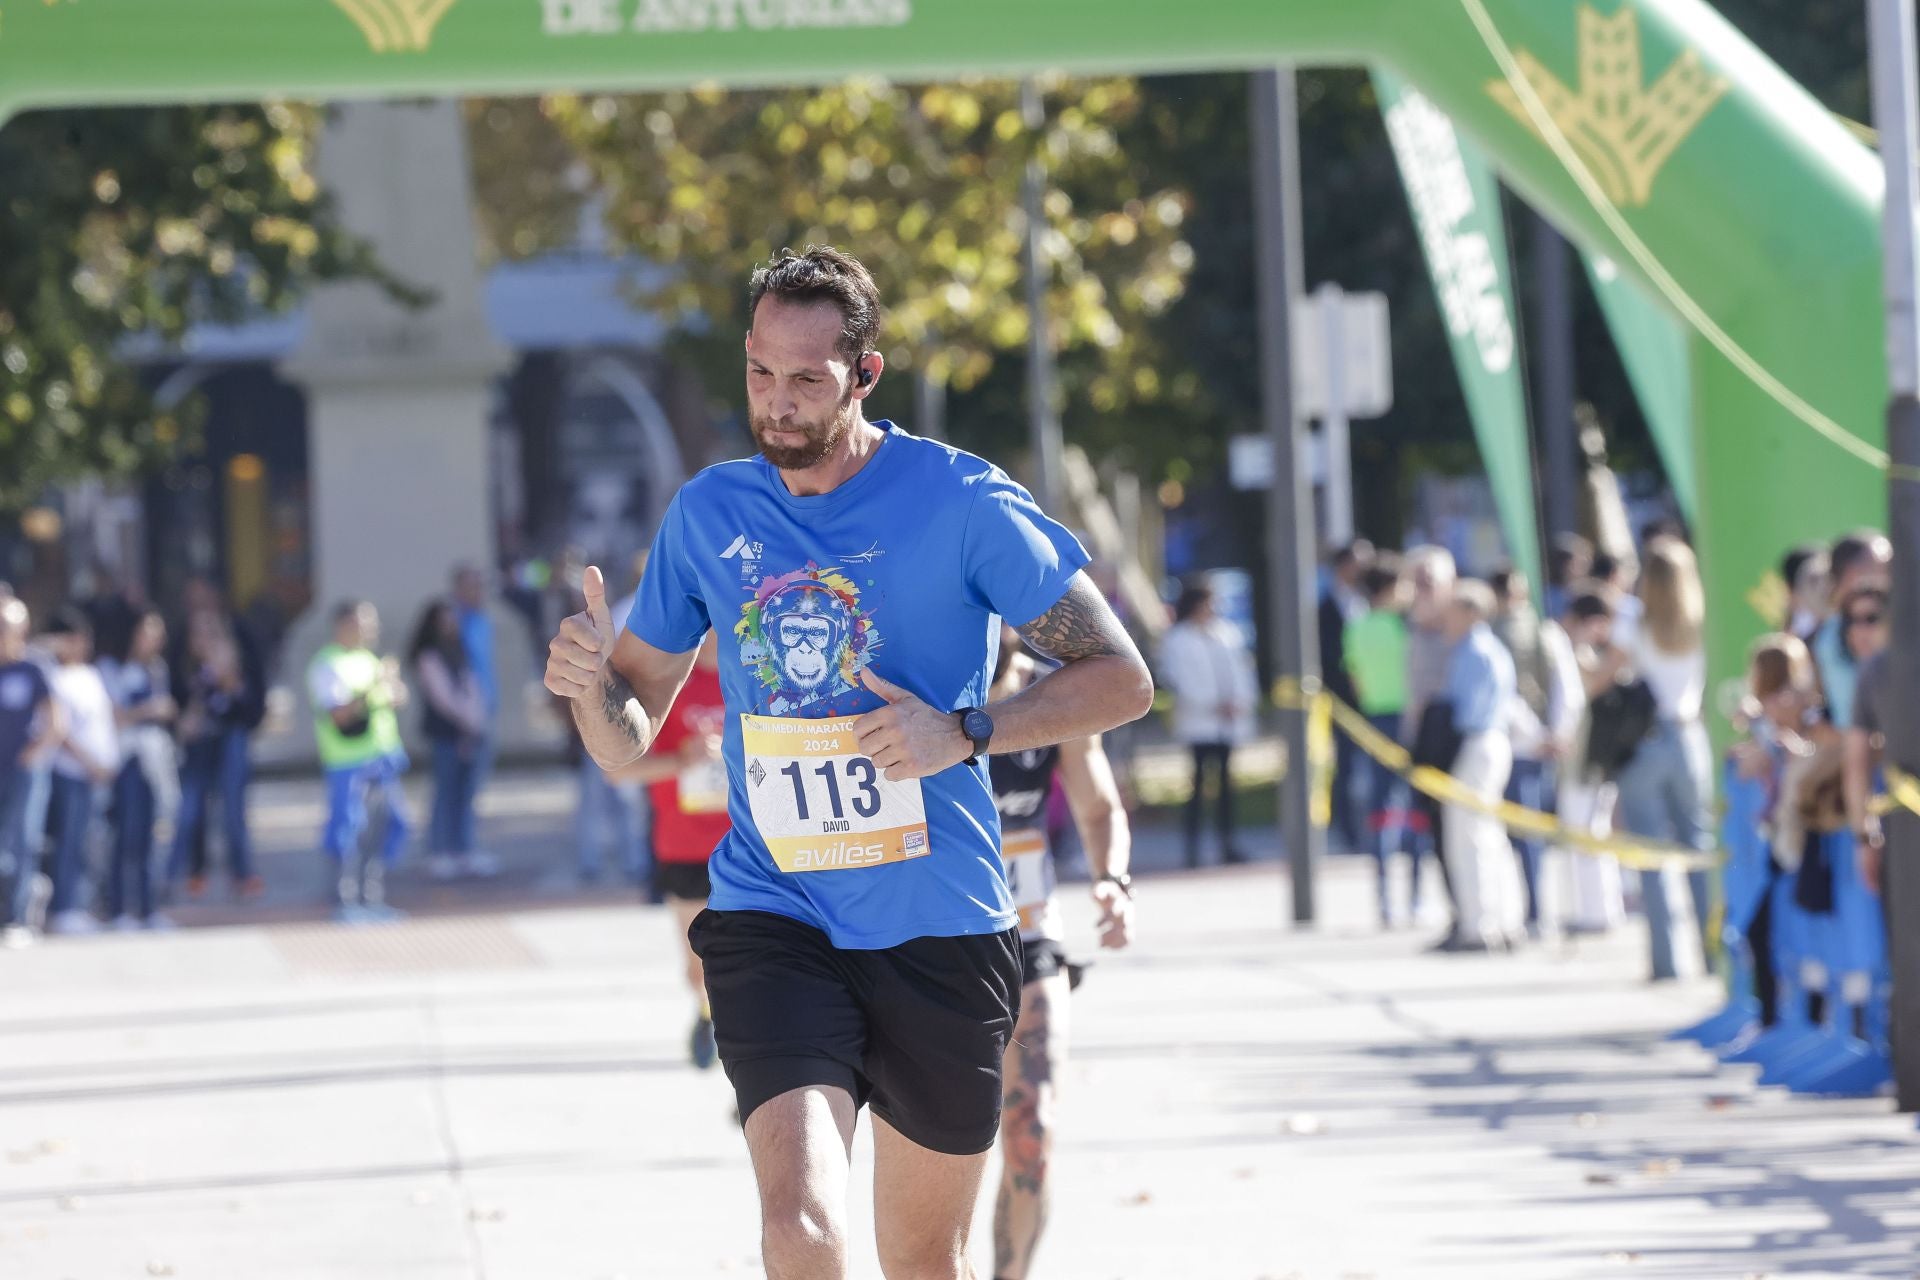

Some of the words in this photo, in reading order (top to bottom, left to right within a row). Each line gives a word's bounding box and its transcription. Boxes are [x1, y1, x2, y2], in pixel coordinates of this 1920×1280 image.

[772, 723, 804, 734] MEDIA
[806, 719, 854, 735] MARATÓ
[802, 739, 840, 752] 2024
[781, 757, 881, 820] 113
[823, 820, 850, 833] DAVID
[793, 841, 884, 868] avilés
